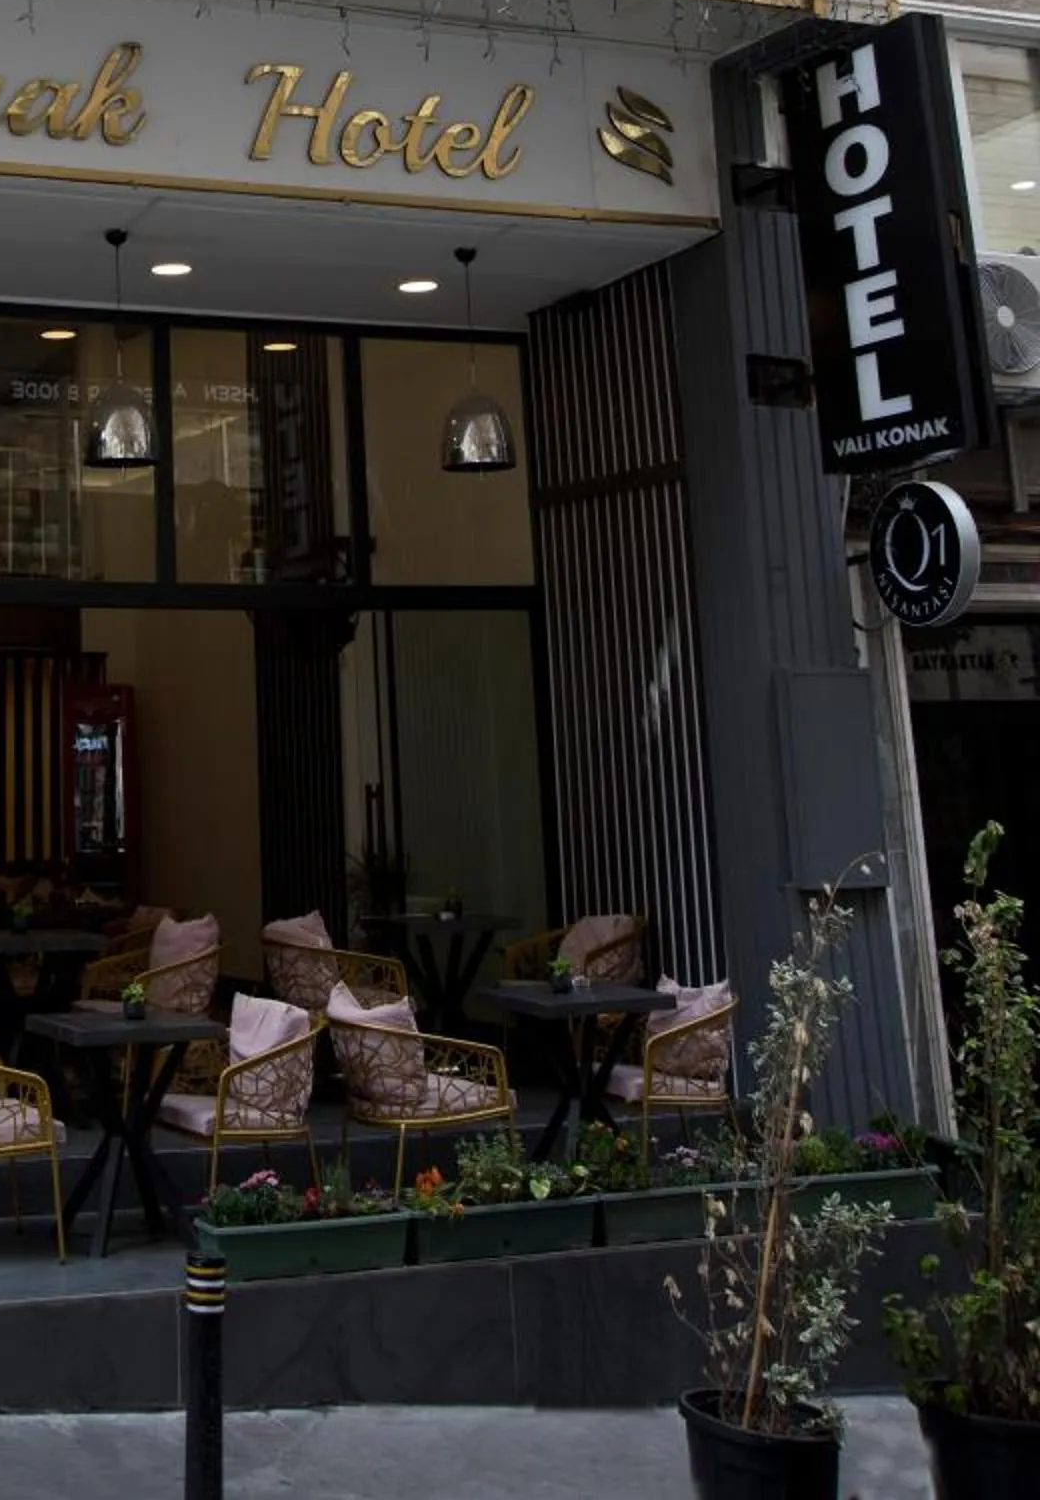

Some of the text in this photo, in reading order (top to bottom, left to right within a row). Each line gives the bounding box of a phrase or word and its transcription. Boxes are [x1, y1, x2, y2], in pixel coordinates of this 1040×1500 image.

[243, 62, 536, 182] Hotel
[815, 43, 913, 422] HOTEL
[876, 417, 950, 449] KONAK
